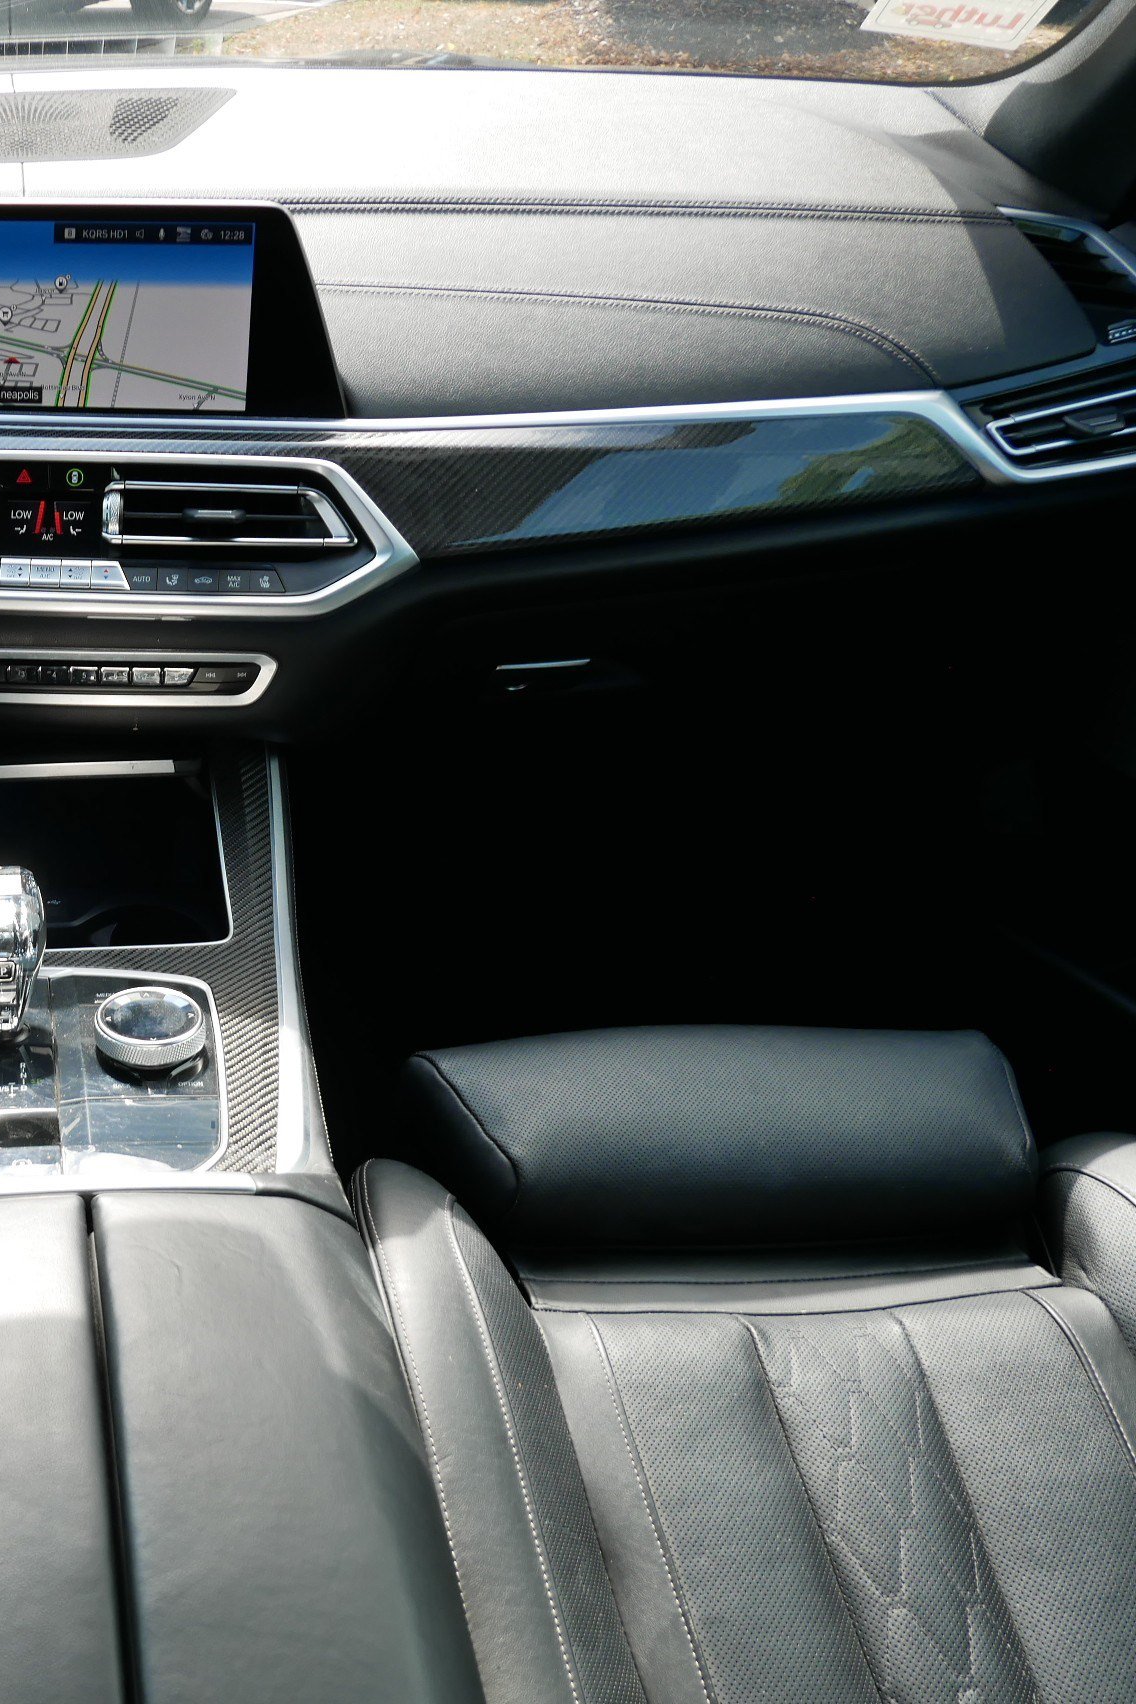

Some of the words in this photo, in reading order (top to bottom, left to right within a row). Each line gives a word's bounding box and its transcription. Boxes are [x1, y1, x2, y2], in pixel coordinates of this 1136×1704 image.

[110, 228, 129, 240] HD1
[220, 229, 246, 240] 12:28
[10, 509, 33, 519] LOW
[63, 510, 85, 521] LOW
[41, 533, 54, 541] A/C
[132, 575, 151, 583] AUTO
